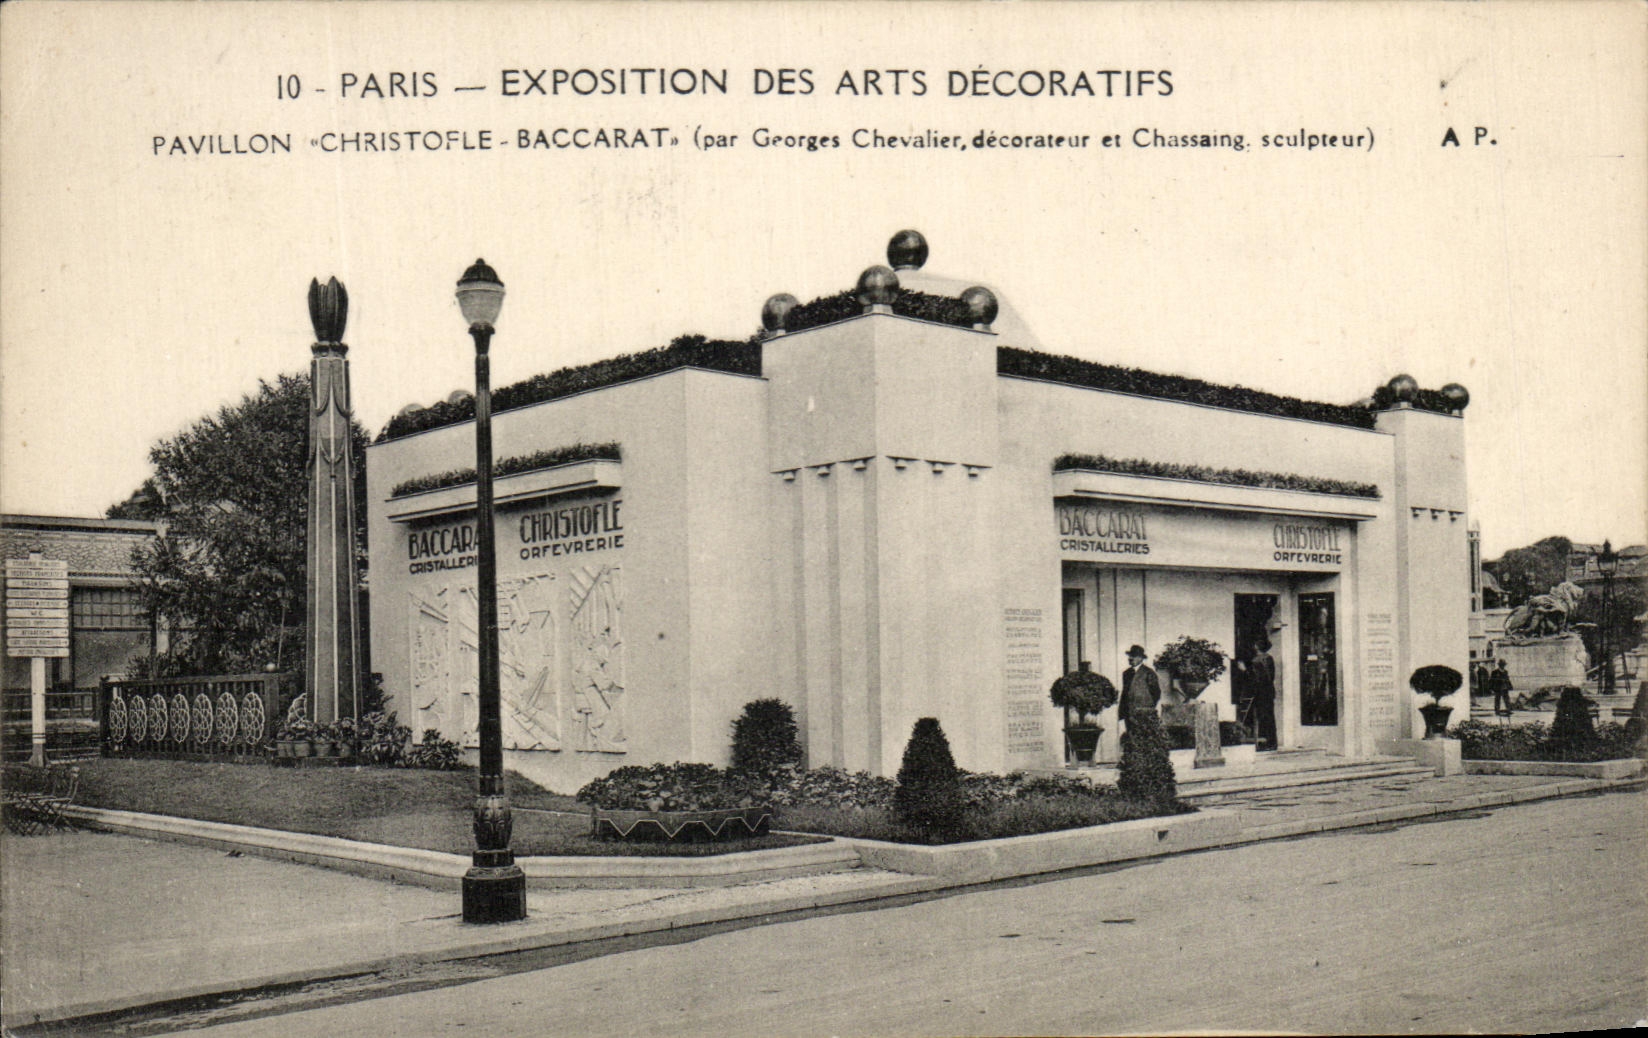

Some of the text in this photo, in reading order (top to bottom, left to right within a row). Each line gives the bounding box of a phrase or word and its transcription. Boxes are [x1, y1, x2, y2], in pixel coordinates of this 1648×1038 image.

[519, 499, 624, 544] CHRISTOFLE
[1059, 506, 1147, 541] BACCARAT
[408, 525, 480, 560] BACCARA
[519, 535, 624, 561] ORFEVRERIE
[1060, 539, 1150, 555] CRISTALLERIES
[1273, 523, 1342, 551] CHRISTOFLE
[409, 555, 479, 575] CRISTALLERI
[1273, 551, 1343, 565] ORFEVRERIE
